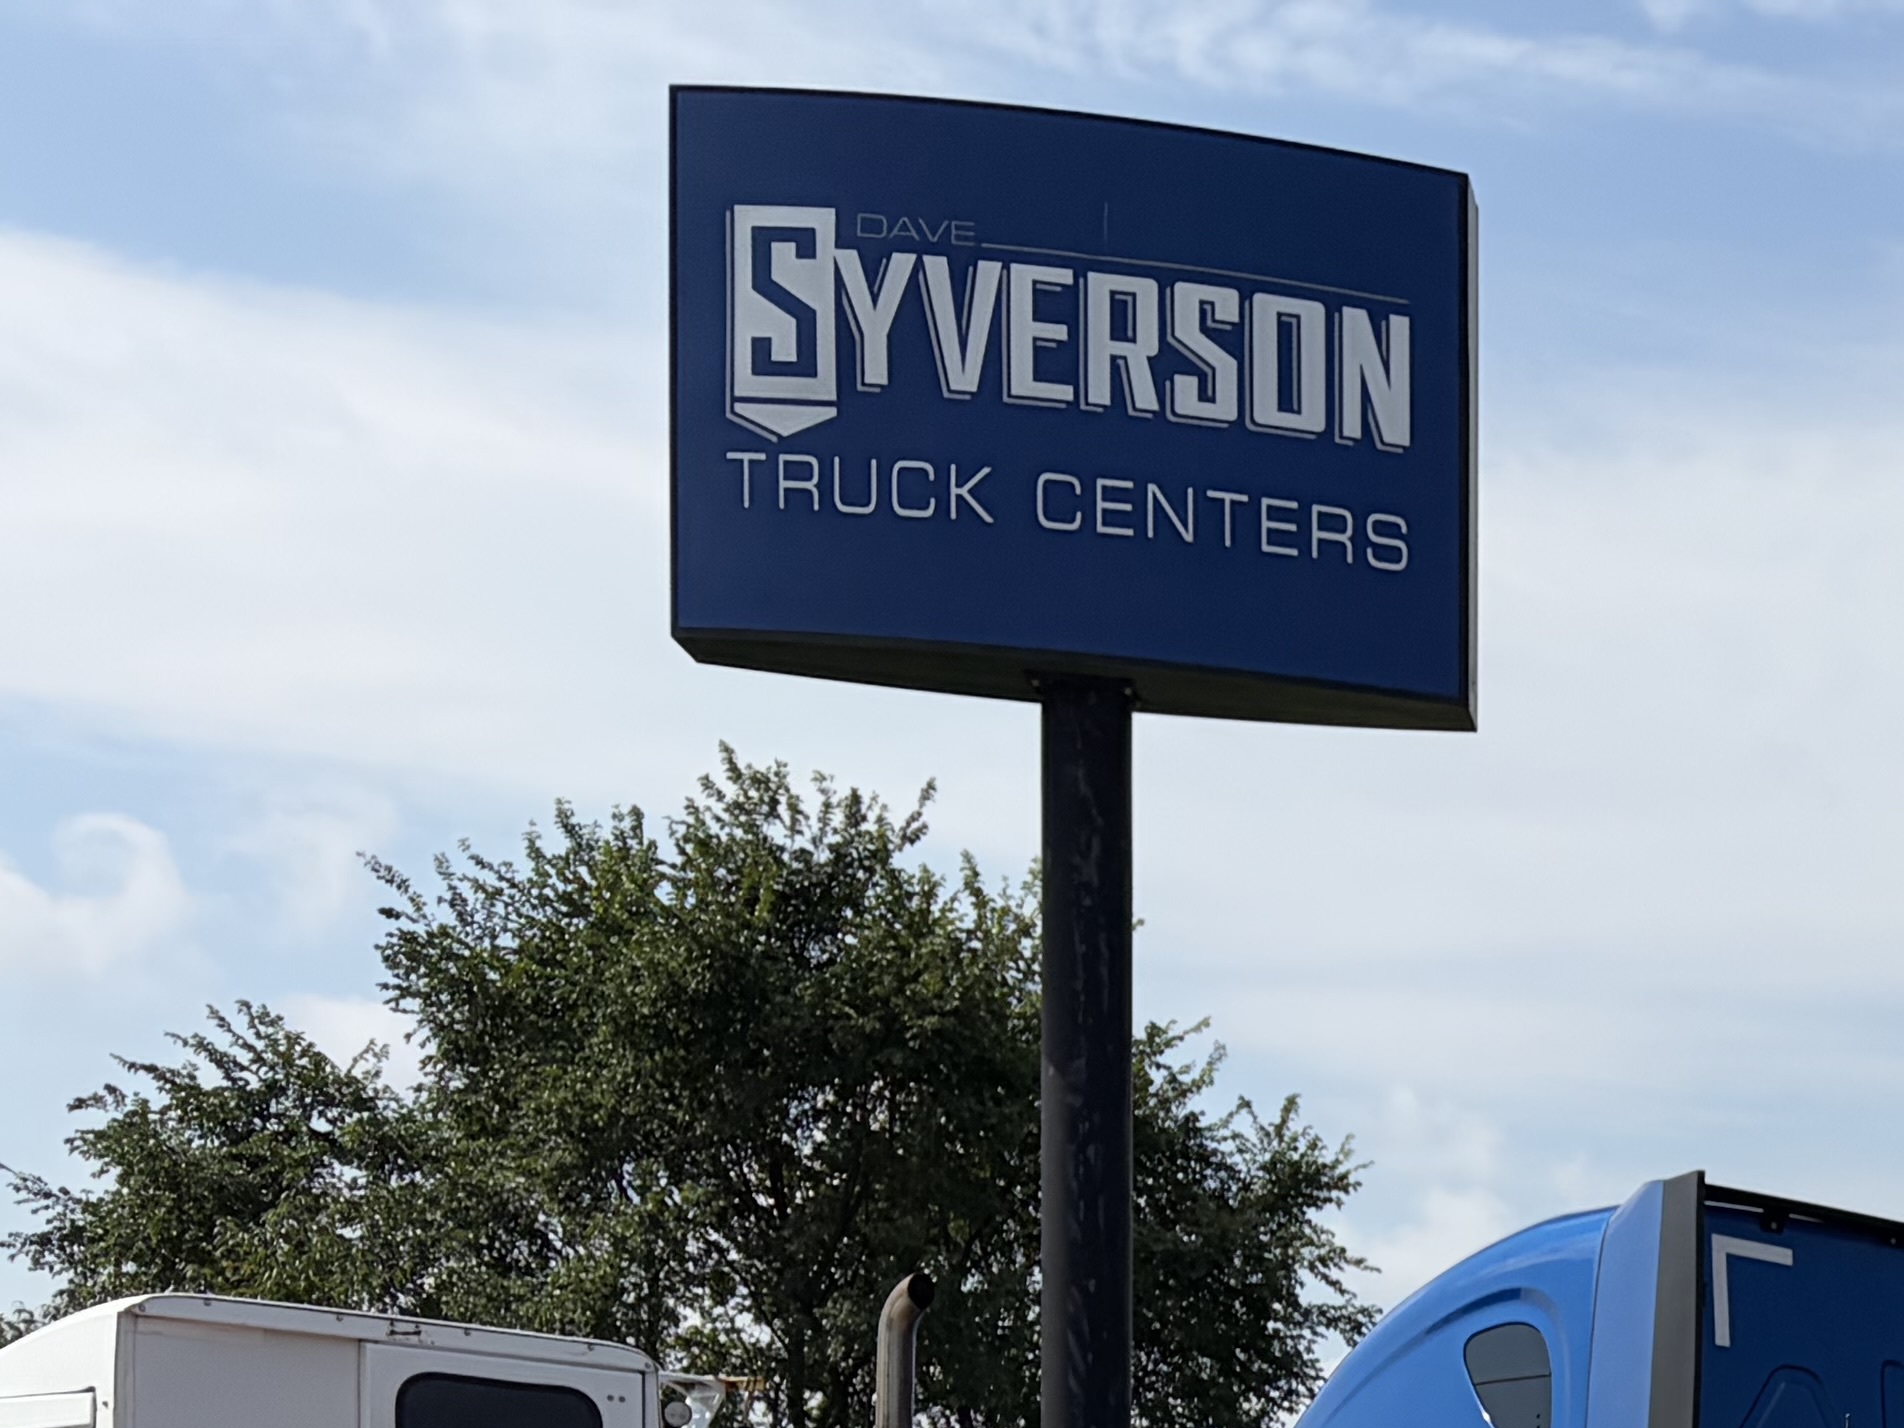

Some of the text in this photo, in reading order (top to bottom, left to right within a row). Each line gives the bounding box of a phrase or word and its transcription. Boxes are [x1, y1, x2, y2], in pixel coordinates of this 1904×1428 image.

[855, 211, 976, 247] DAVE
[726, 203, 1411, 452] SYVERSON
[725, 452, 1409, 573] TRUCK CENTERS
